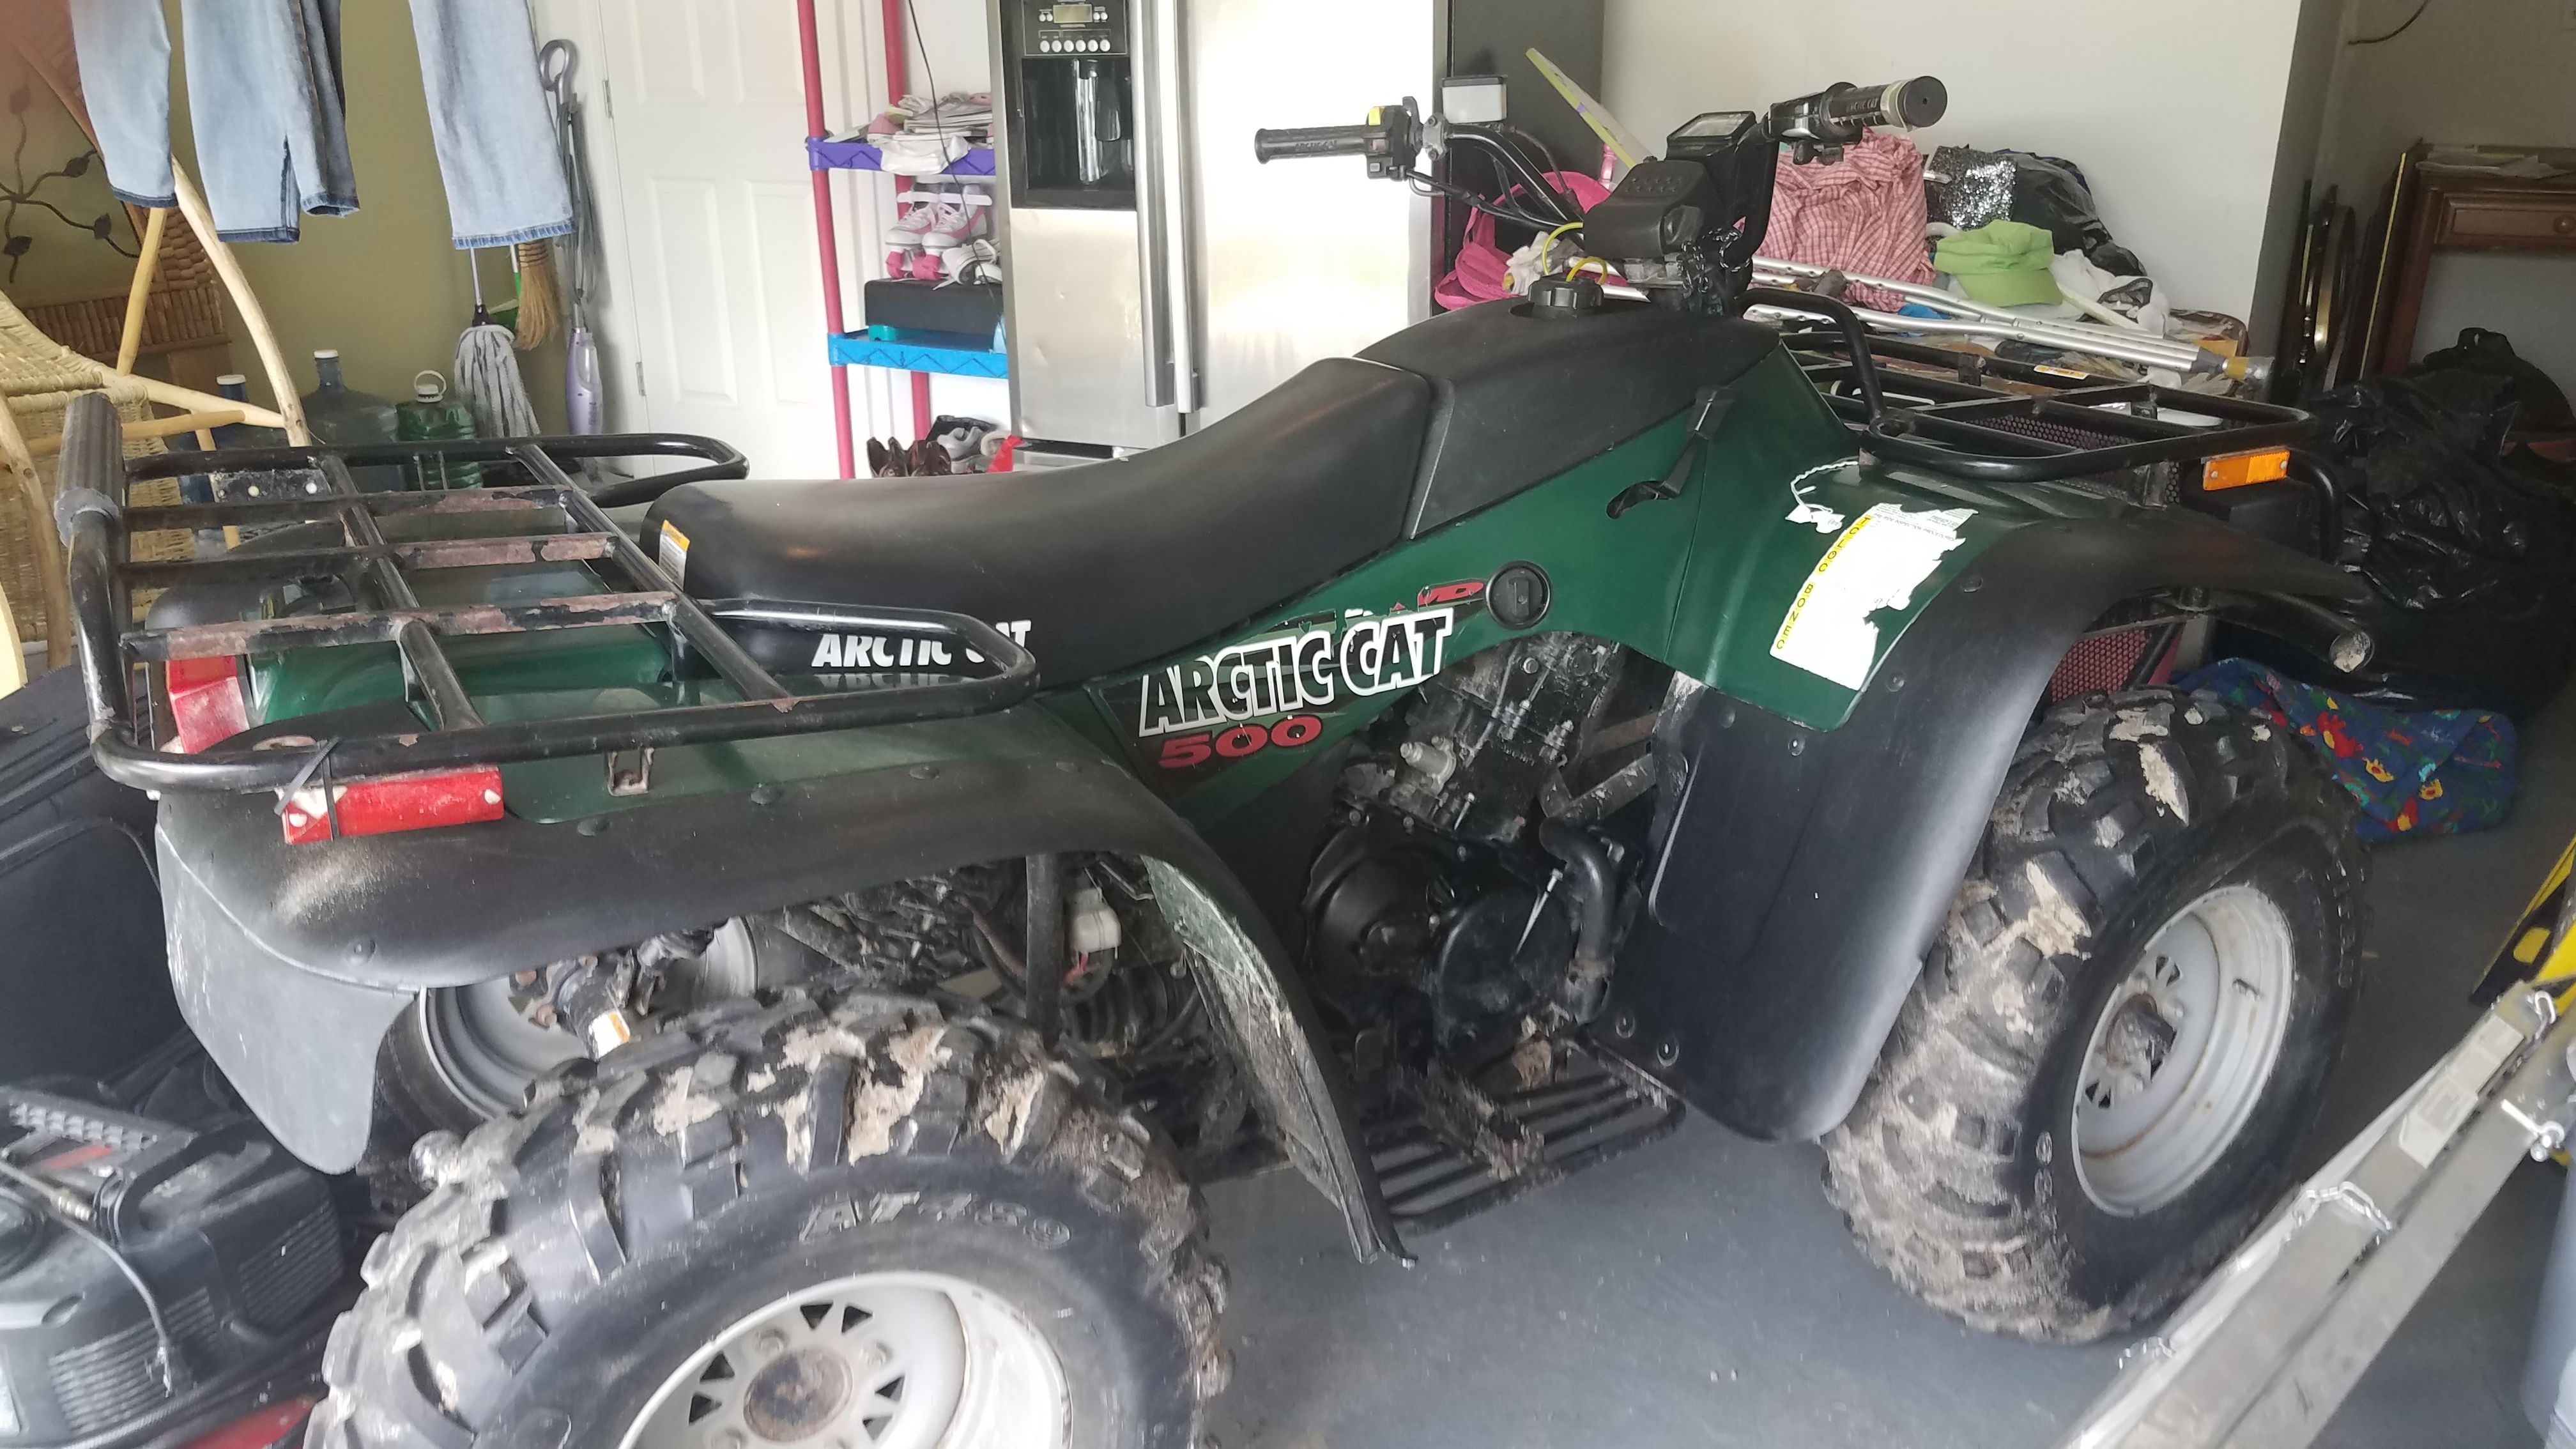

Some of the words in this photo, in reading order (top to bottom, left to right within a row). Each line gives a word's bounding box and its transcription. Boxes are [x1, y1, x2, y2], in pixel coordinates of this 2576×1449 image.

[1139, 630, 1334, 737] ARCTIC
[1340, 607, 1453, 696] CAT
[1159, 715, 1322, 769] 500
